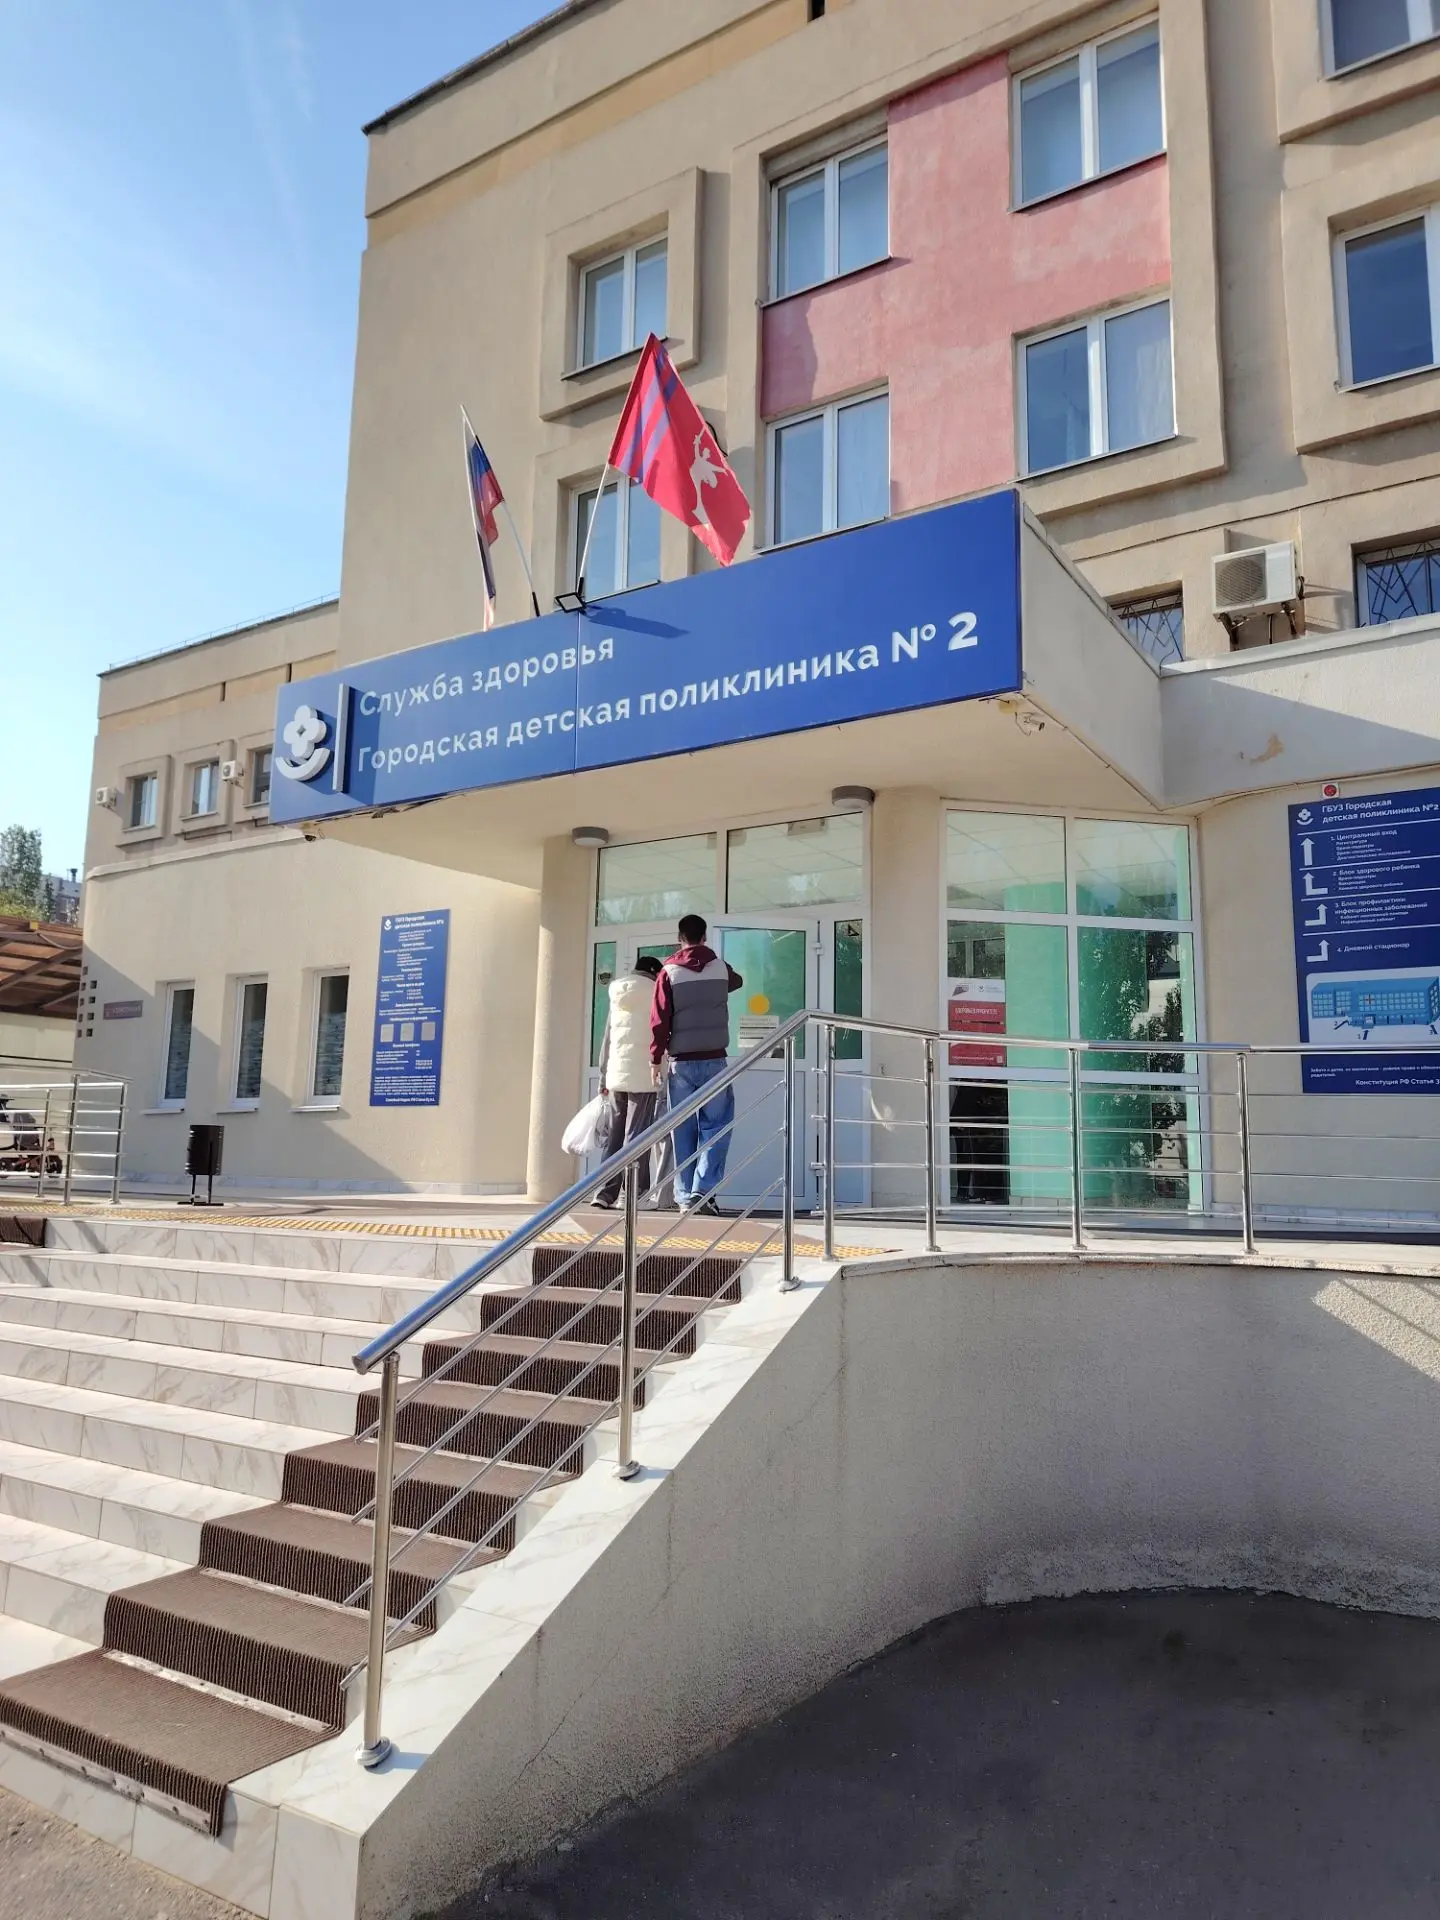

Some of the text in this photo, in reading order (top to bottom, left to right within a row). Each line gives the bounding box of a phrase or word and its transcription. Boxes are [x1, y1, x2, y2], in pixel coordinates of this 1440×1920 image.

[360, 637, 614, 717] Служба здоровья
[358, 611, 979, 774] Городская детская поликлиника № 2
[1322, 799, 1392, 813] ГБУЗ Городская
[1322, 803, 1440, 824] детская поликлиника №2
[1336, 830, 1381, 842] Центральный
[1381, 829, 1398, 837] вход
[1339, 868, 1355, 876] Блок
[1356, 866, 1391, 876] здорового
[1391, 864, 1421, 873] ребенка
[1334, 906, 1383, 916] инфекционных
[1384, 902, 1428, 912] заболеваний
[1341, 900, 1357, 908] Блок
[1358, 897, 1406, 907] профилактики
[1343, 944, 1374, 953] Дневной
[1374, 941, 1410, 951] стационар
[1355, 1079, 1399, 1087] Конституция
[1400, 1078, 1410, 1086] РФ
[1410, 1078, 1435, 1086] Статья
